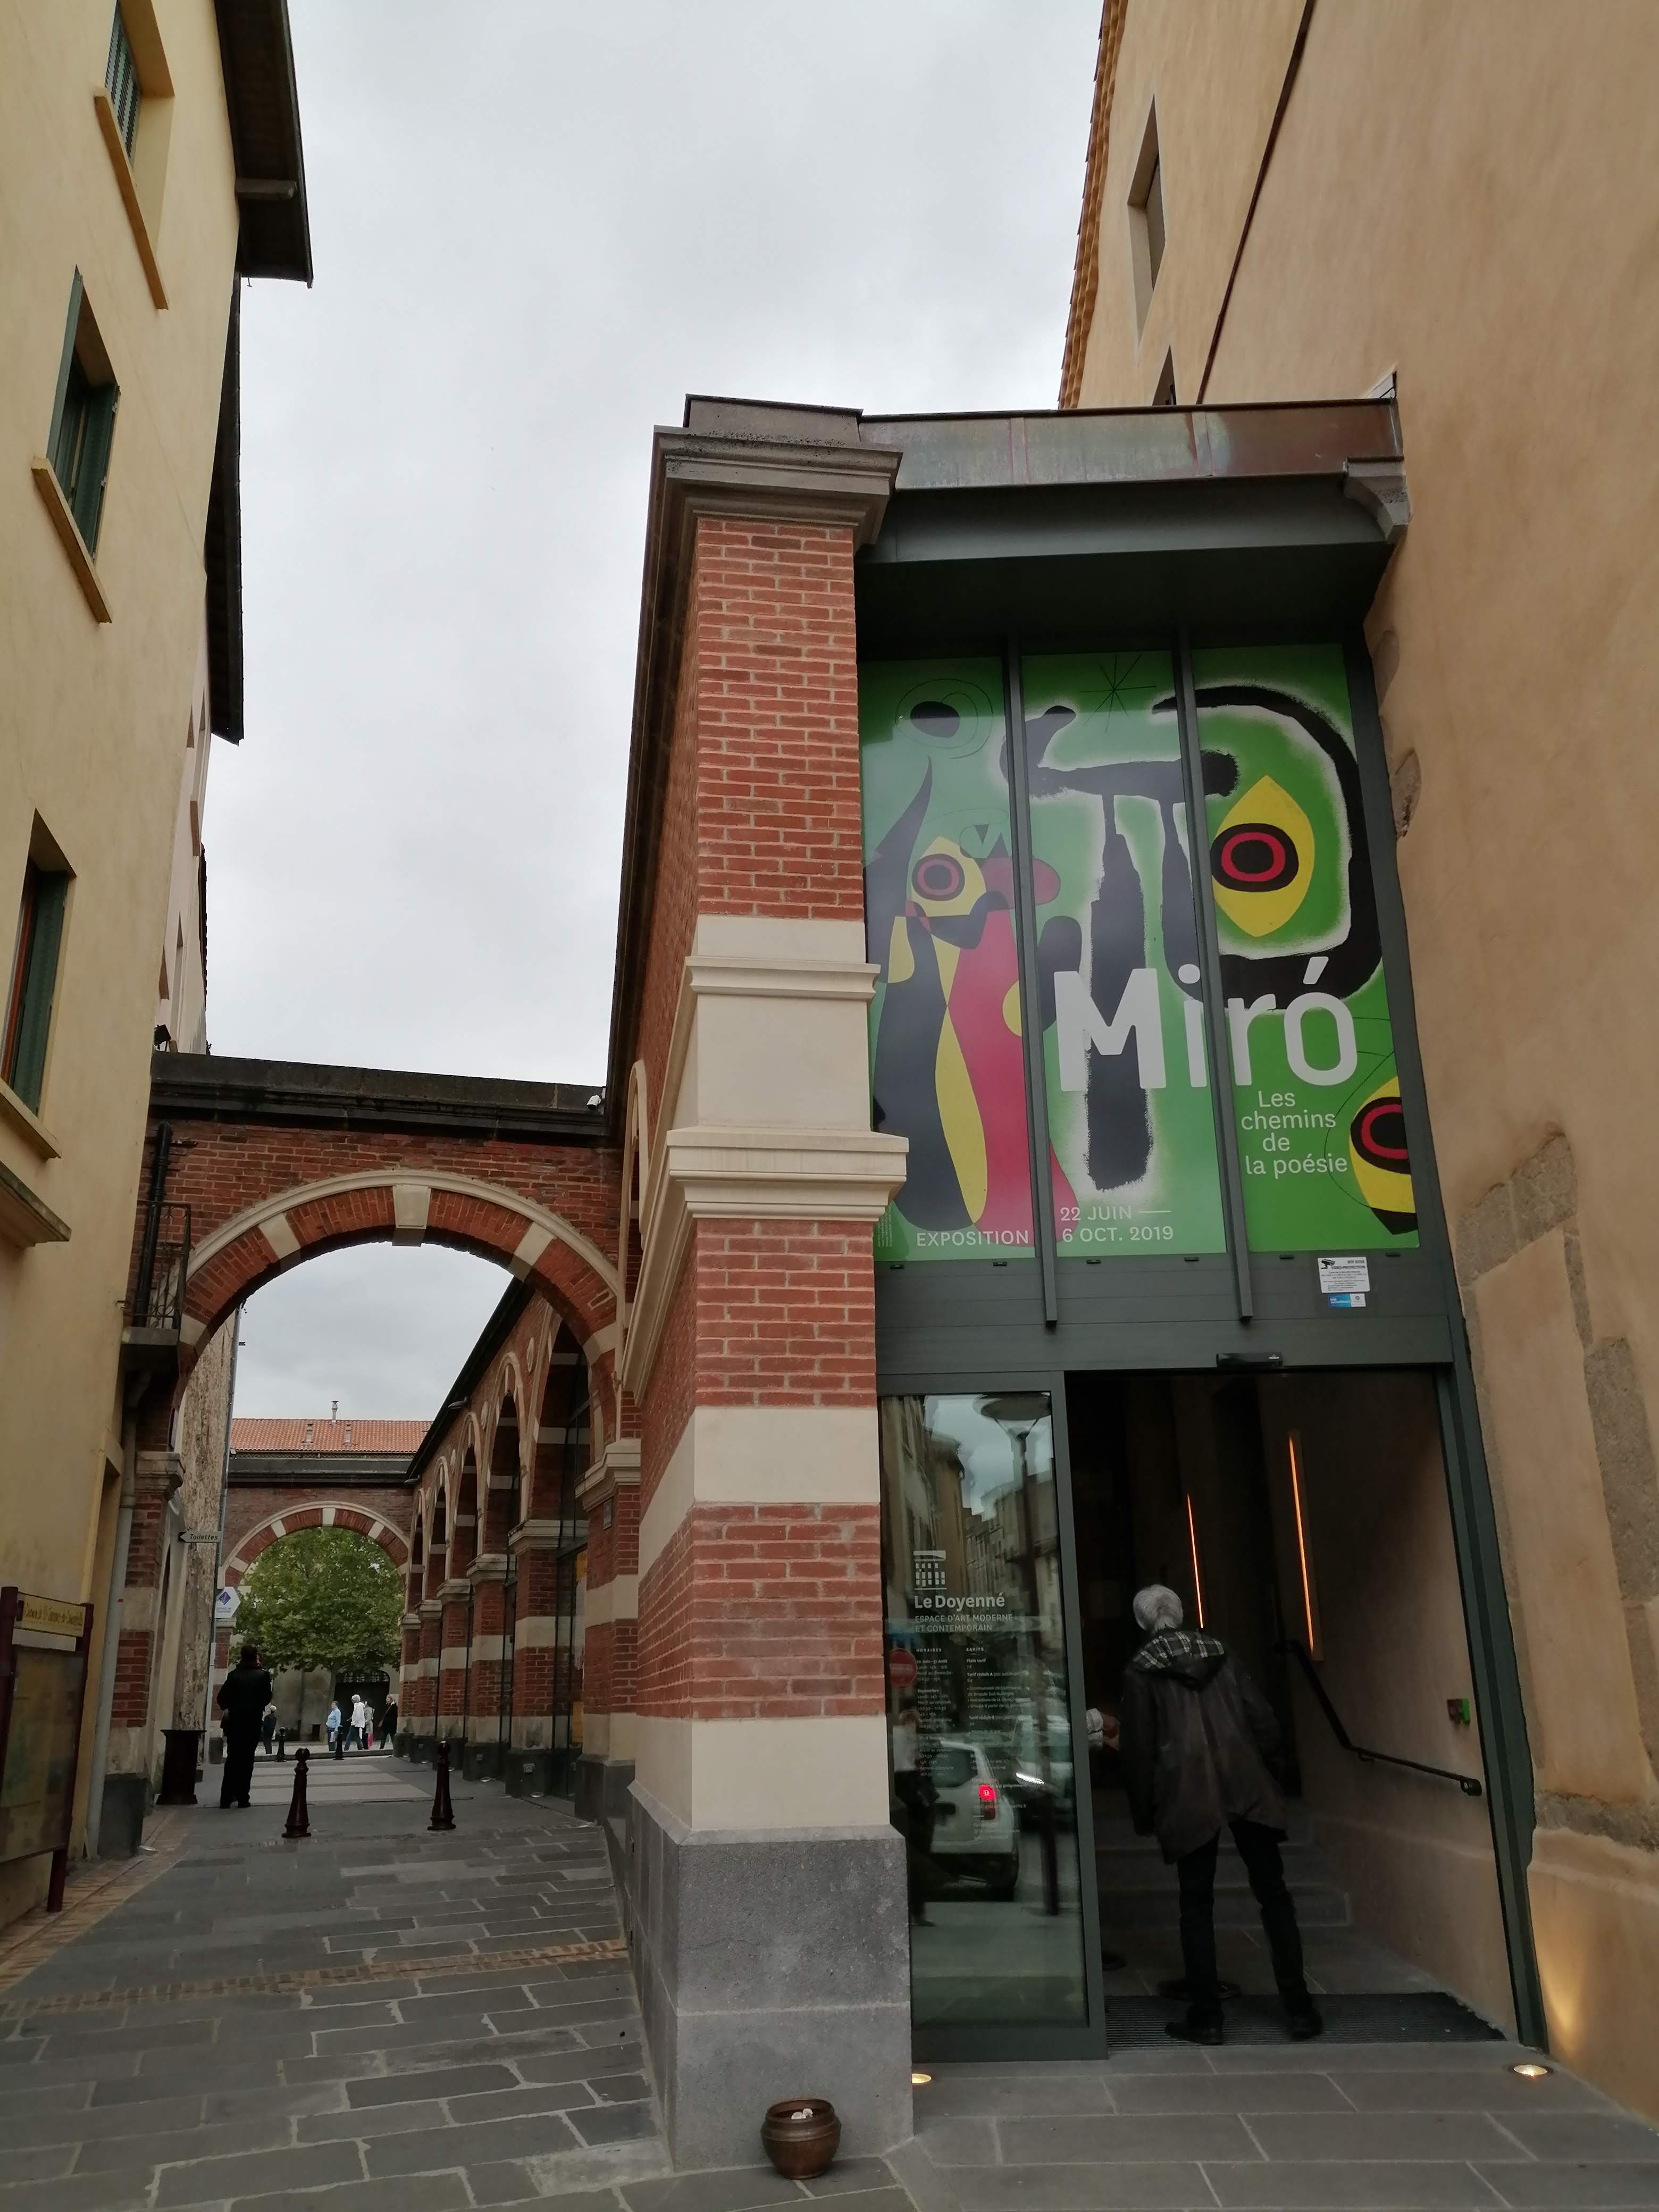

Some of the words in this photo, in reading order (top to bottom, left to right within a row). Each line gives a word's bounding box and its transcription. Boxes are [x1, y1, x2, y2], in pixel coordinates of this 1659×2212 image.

[1053, 956, 1358, 1091] Miró
[1258, 1091, 1295, 1107] Les
[1241, 1109, 1336, 1130] chemins
[1262, 1132, 1290, 1151] de
[1245, 1155, 1266, 1174] la
[1273, 1153, 1347, 1179] poésie
[1060, 1207, 1081, 1221] 22
[1087, 1205, 1132, 1220] JUIN
[917, 1230, 1029, 1246] EXPOSITION
[1062, 1228, 1073, 1243] 6
[1079, 1227, 1123, 1242] OCT.
[1129, 1226, 1174, 1241] 2019
[915, 1595, 932, 1608] Le
[935, 1591, 1006, 1612] Doyenné
